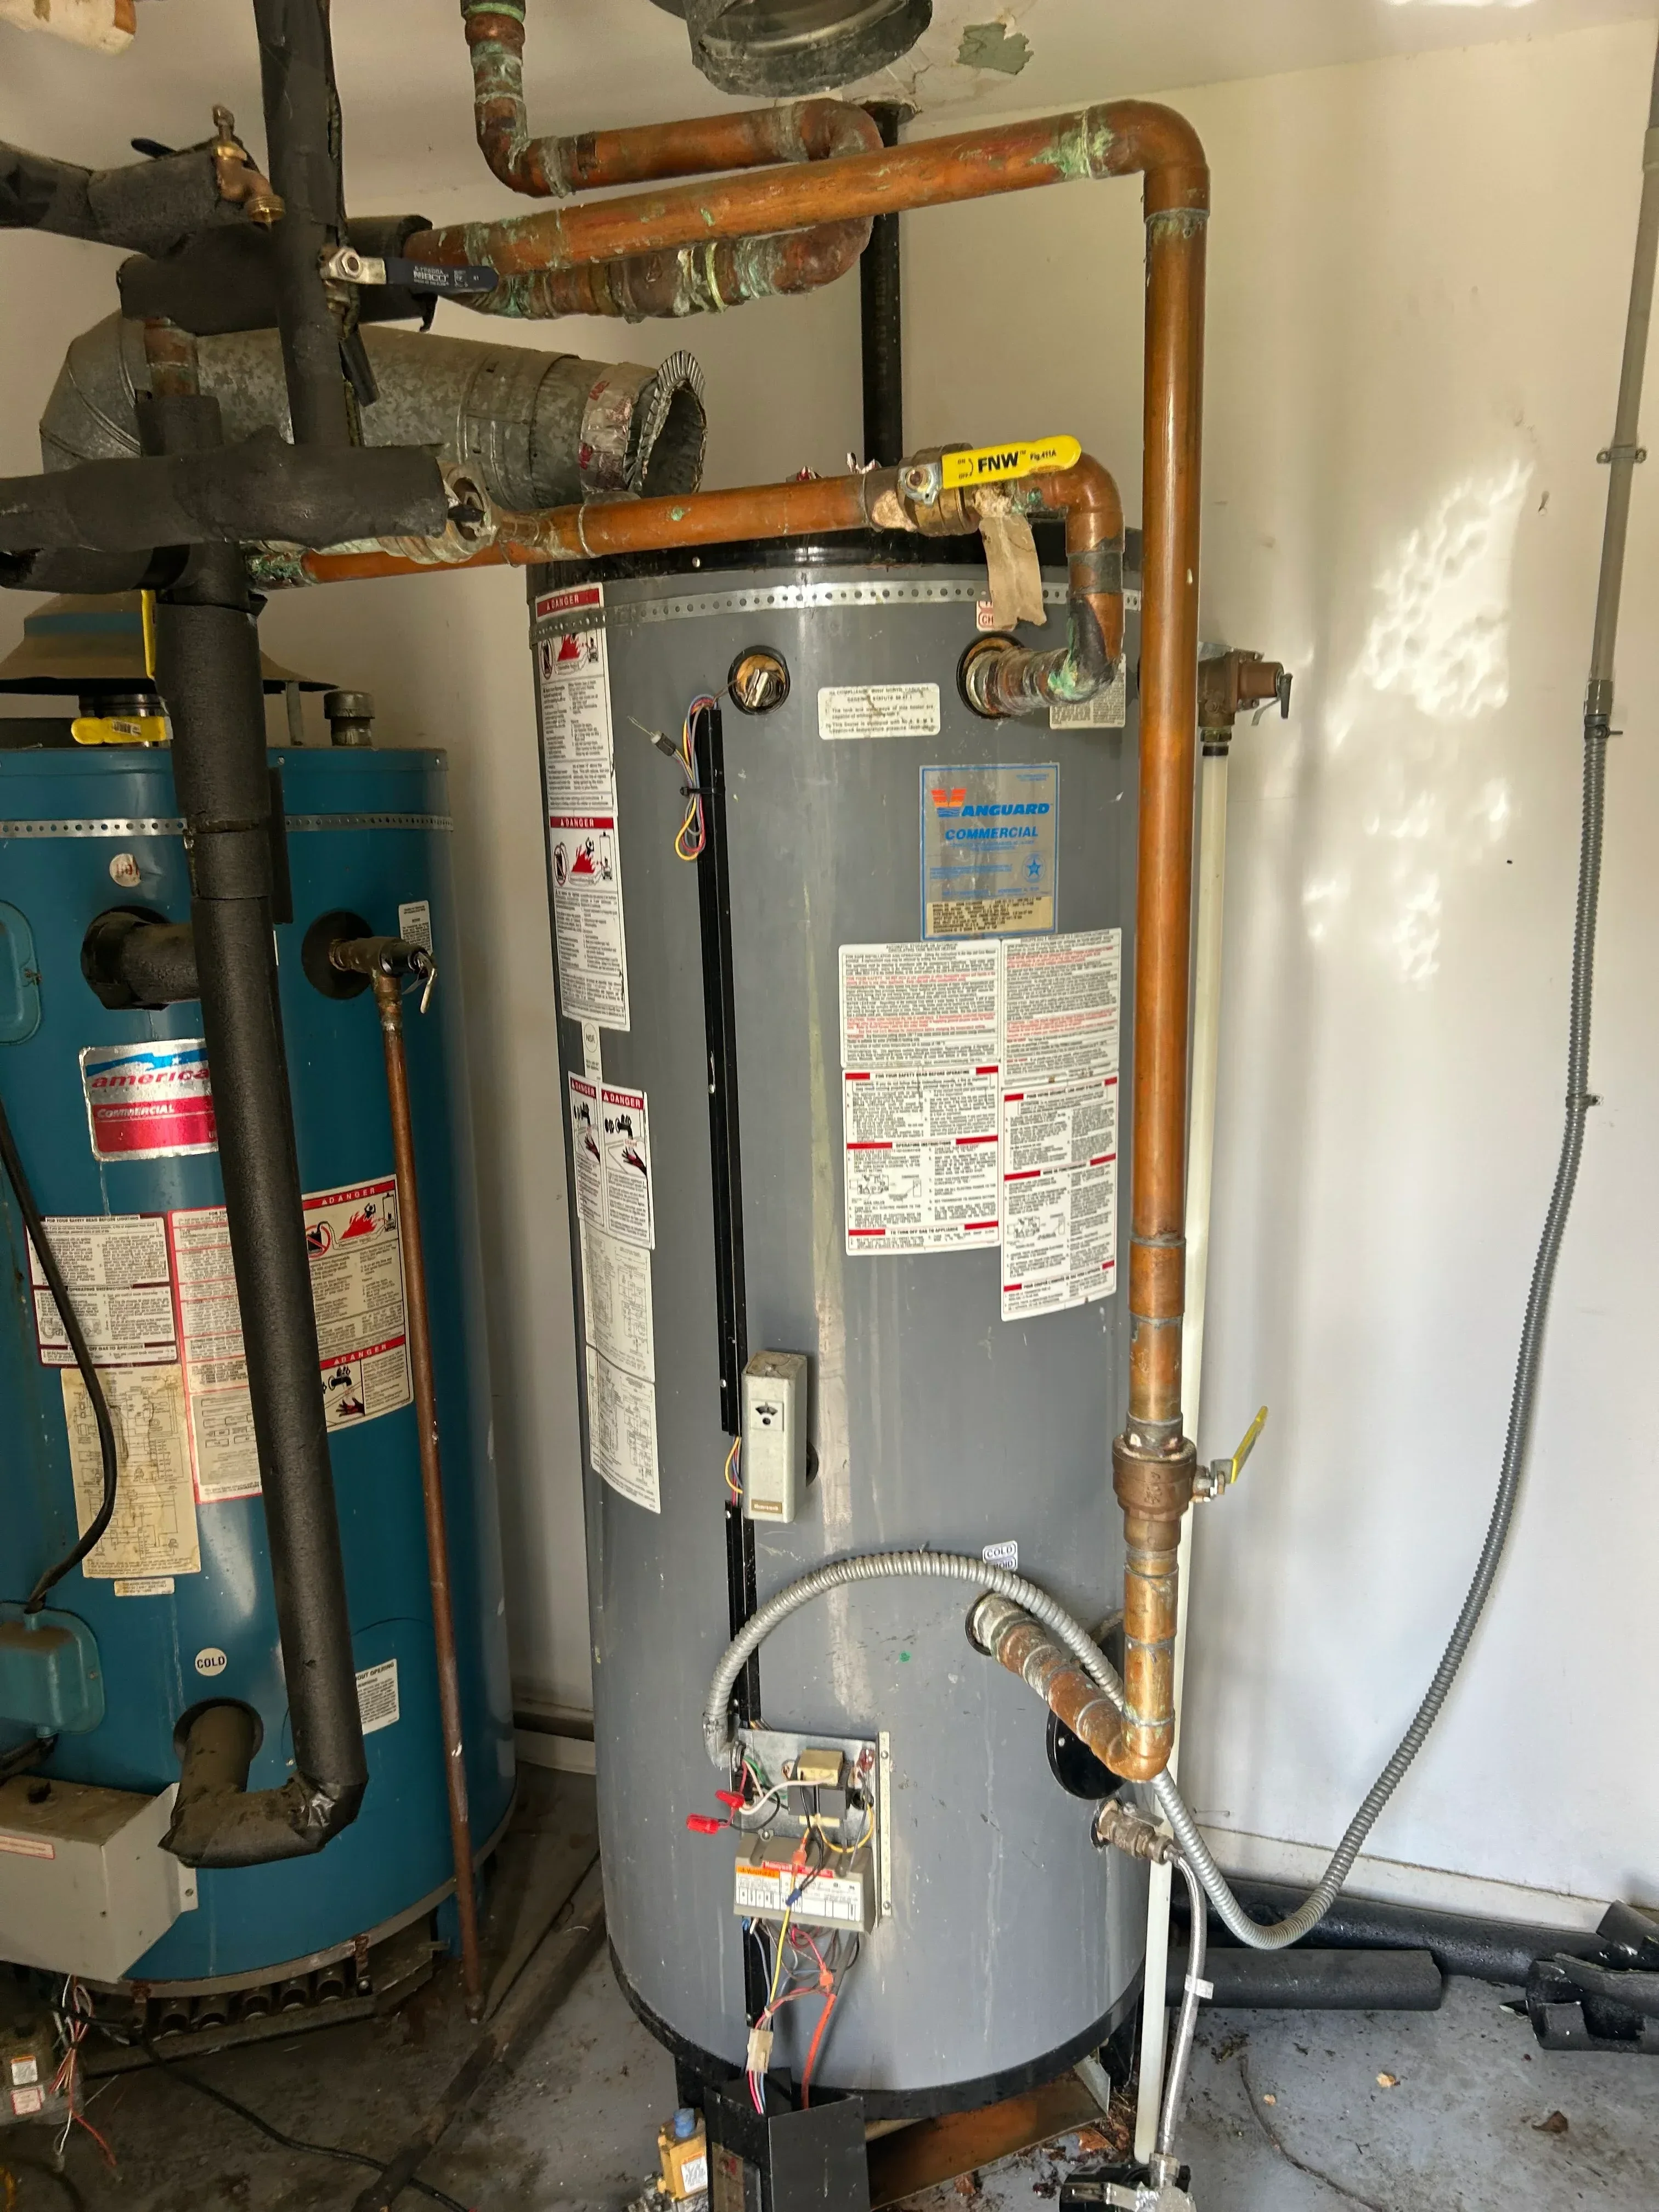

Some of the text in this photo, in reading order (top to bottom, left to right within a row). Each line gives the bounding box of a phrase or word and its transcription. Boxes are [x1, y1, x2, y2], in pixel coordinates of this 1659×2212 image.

[414, 271, 447, 282] NIBCO
[978, 451, 1019, 473] FNW
[551, 595, 579, 609] DANGER
[565, 818, 594, 828] DANGER
[945, 826, 1039, 840] COMMERCIAL
[576, 1081, 595, 1097] DANGER
[610, 1093, 641, 1109] DANGER
[97, 1104, 175, 1119] COMMERCIAL
[329, 1188, 376, 1204] DANGER
[342, 1345, 386, 1361] DANGER
[988, 1547, 1012, 1558] COLD
[196, 1656, 225, 1669] COLD
